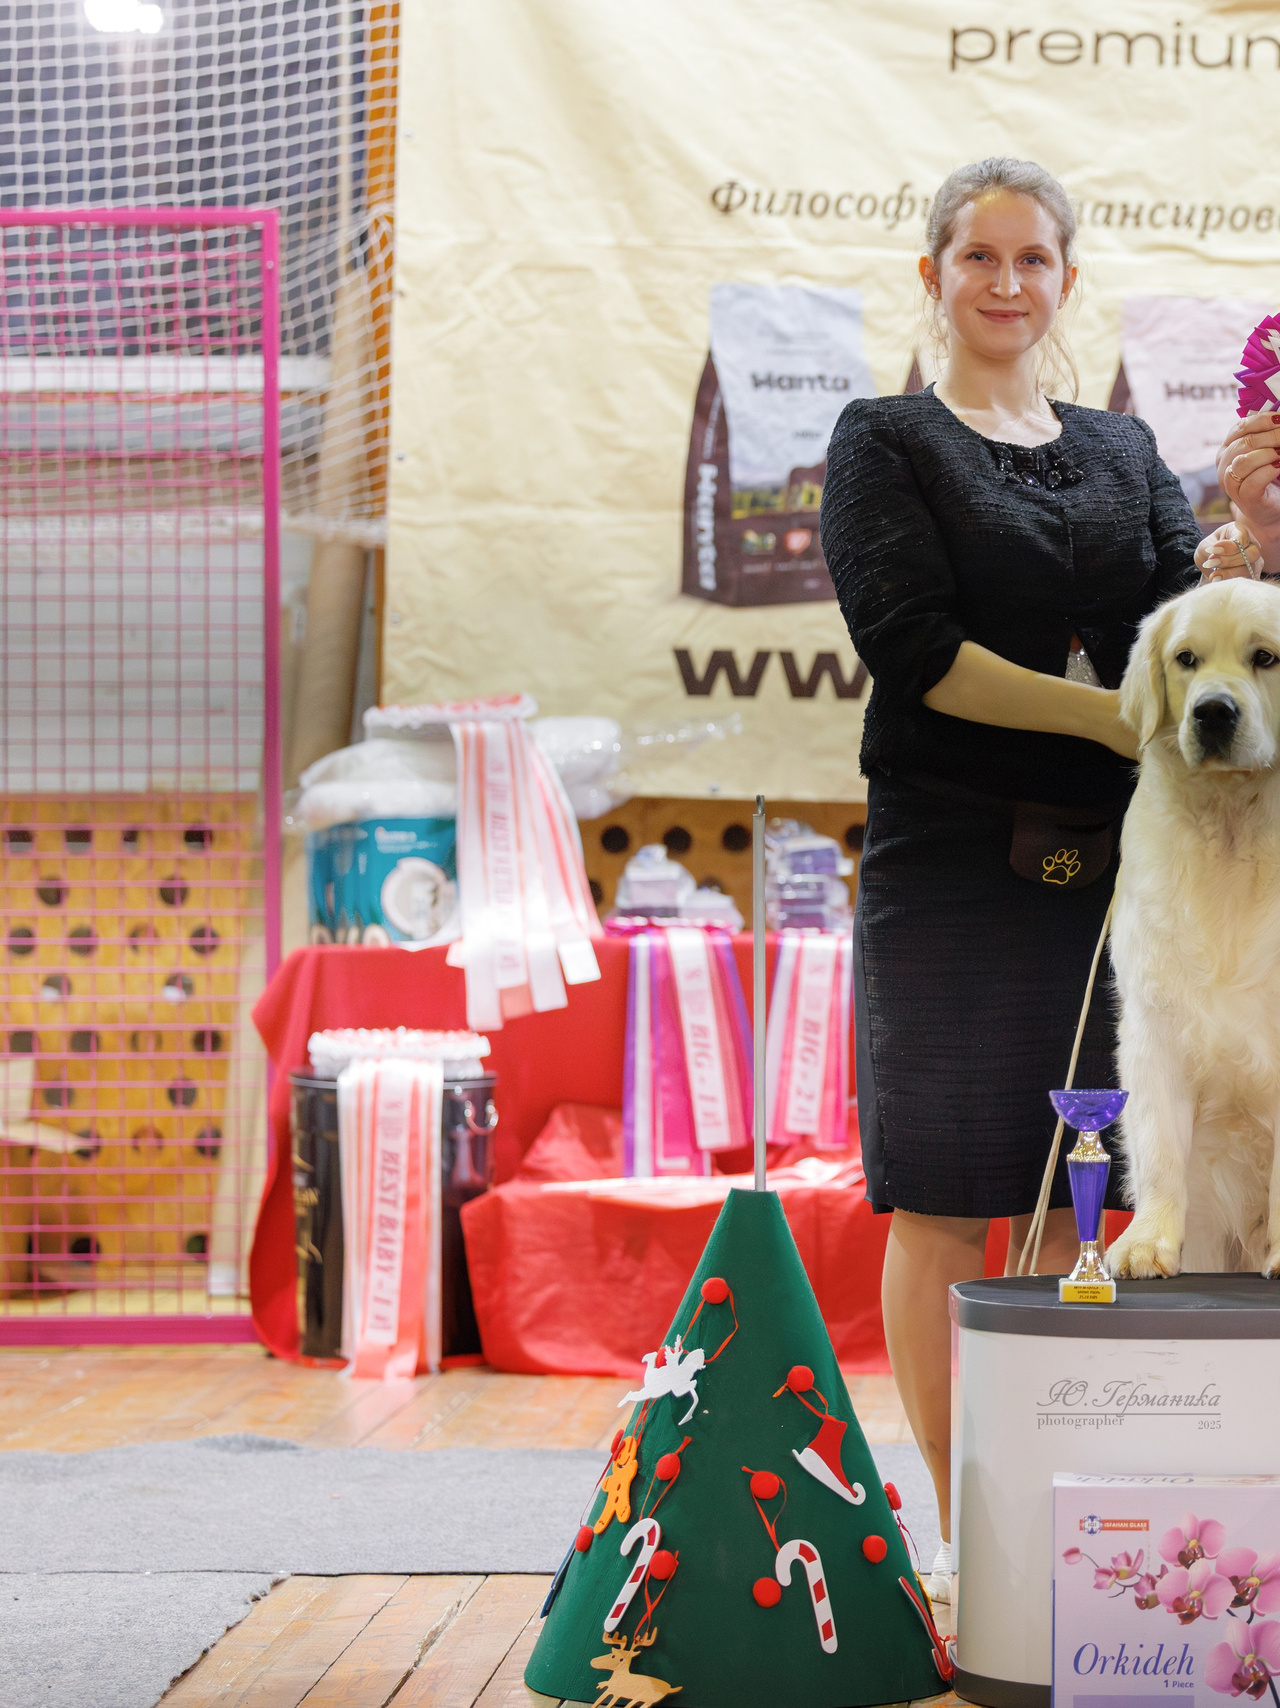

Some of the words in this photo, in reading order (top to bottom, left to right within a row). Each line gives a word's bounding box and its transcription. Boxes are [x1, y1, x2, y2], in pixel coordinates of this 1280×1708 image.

[711, 181, 930, 231] Философ
[751, 370, 851, 392] Hanta
[1164, 382, 1239, 401] Hant
[674, 649, 870, 699] ww
[1073, 1642, 1195, 1676] Orkideh
[1163, 1679, 1169, 1688] 1
[1172, 1680, 1195, 1688] Piece
